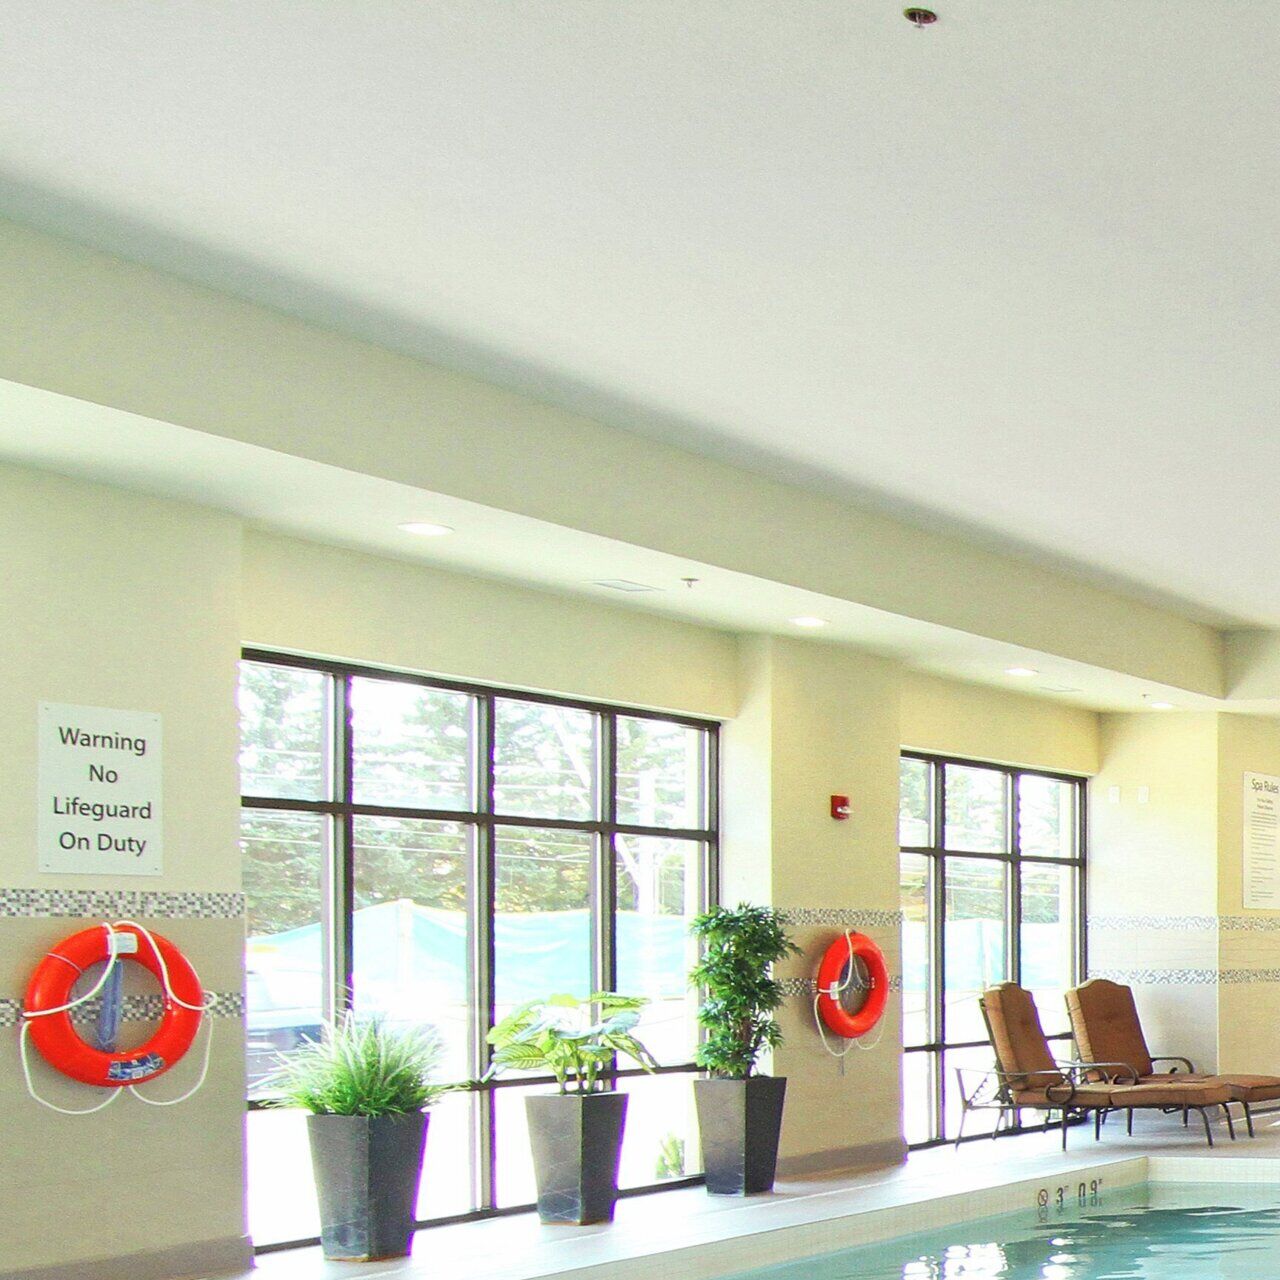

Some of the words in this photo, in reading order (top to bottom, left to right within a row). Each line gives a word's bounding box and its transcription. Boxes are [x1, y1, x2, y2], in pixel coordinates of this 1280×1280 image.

[58, 726, 146, 756] Warning
[89, 764, 118, 783] No
[1251, 778, 1263, 792] Spa
[1264, 780, 1279, 794] Rules
[53, 796, 151, 821] Lifeguard
[59, 832, 90, 850] On
[97, 834, 147, 857] Duty
